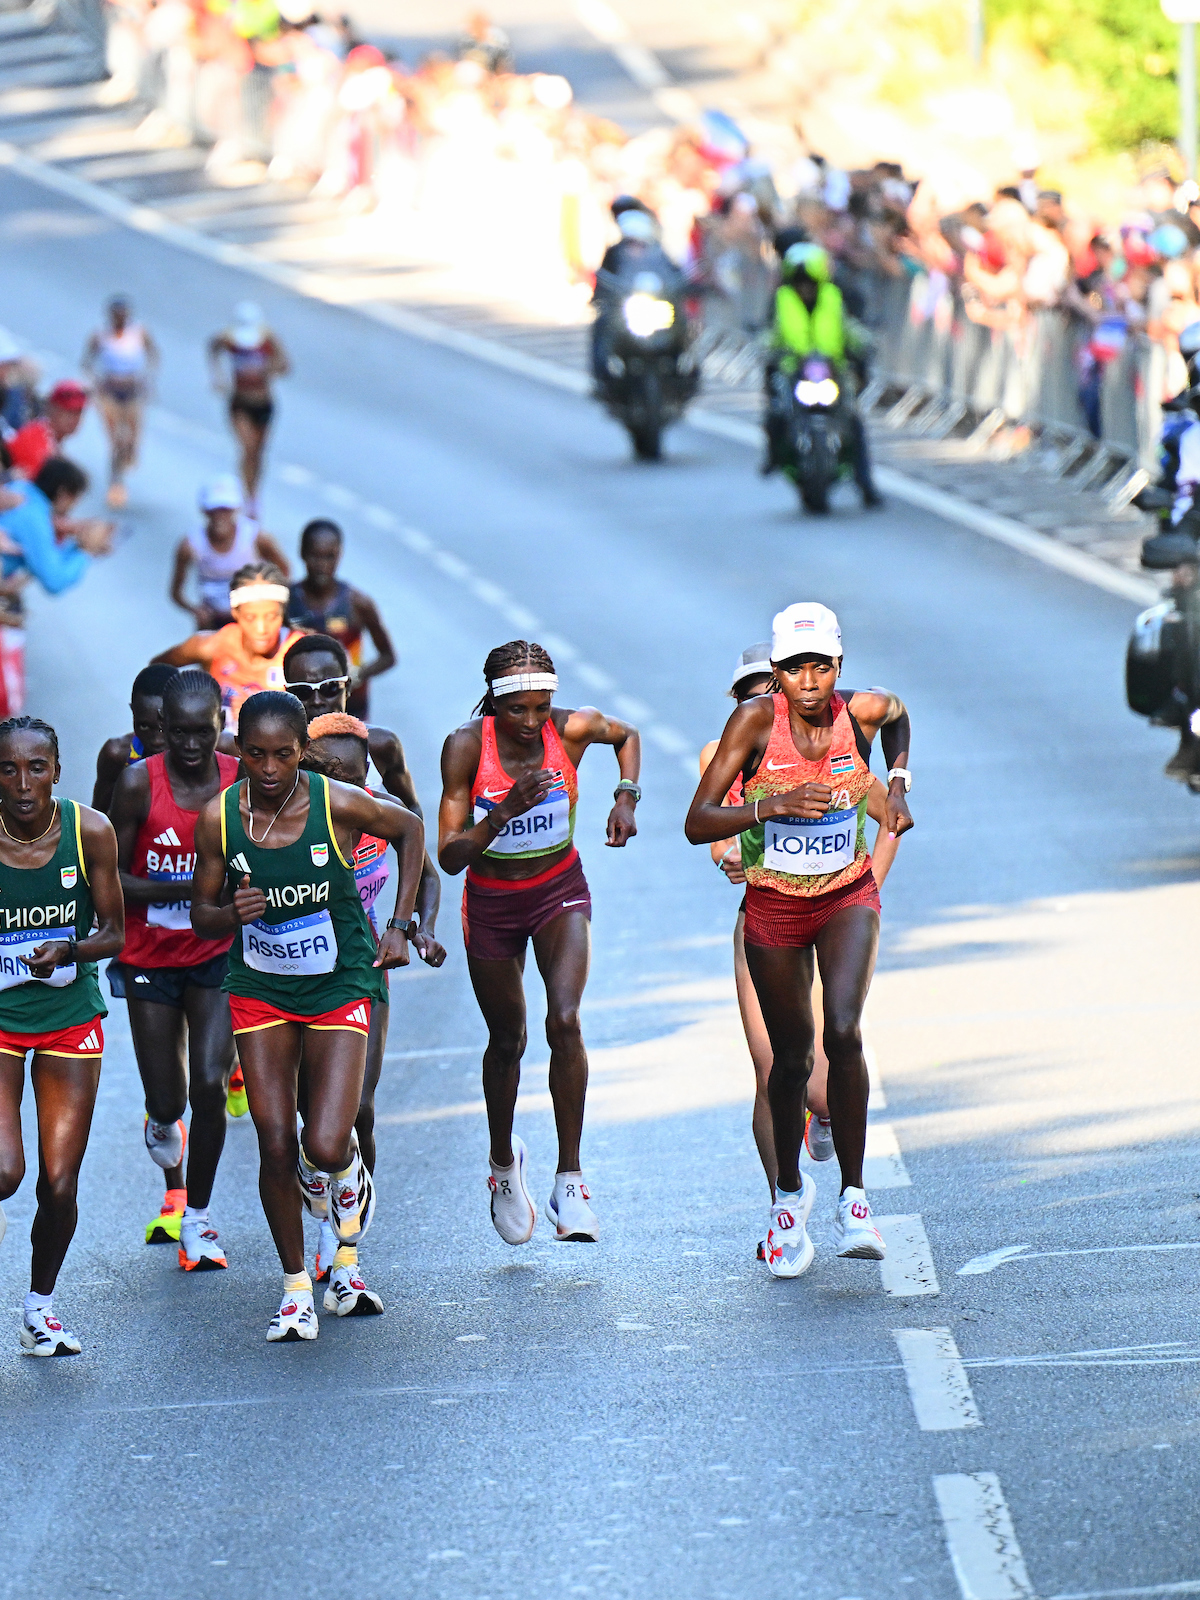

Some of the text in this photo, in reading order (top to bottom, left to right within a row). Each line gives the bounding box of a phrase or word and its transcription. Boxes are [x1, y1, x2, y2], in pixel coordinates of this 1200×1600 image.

[773, 829, 851, 856] LOKEDI
[146, 849, 197, 874] BAH
[265, 880, 330, 908] HIOPIA
[0, 930, 50, 944] PARIS 2024
[281, 920, 305, 932] 2024
[248, 934, 330, 960] ASSEFA
